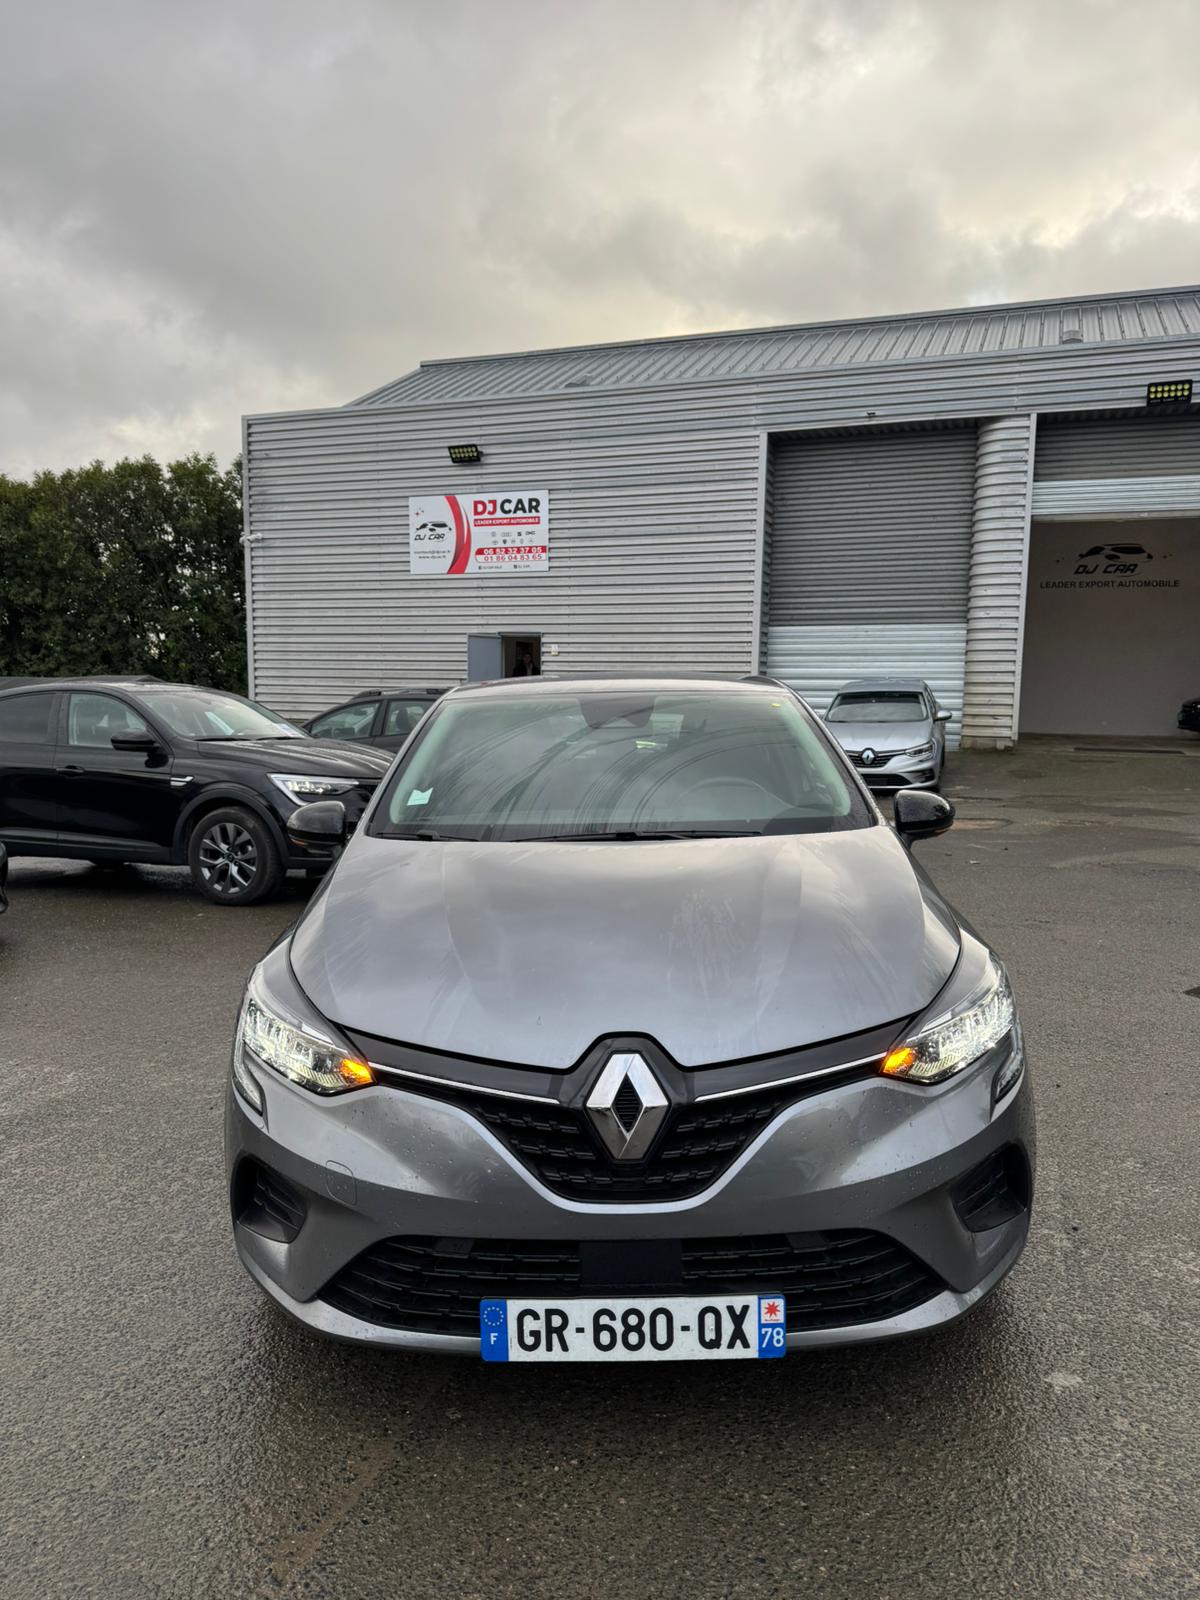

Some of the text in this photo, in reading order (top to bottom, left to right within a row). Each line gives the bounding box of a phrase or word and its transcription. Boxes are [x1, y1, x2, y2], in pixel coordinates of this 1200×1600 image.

[473, 498, 541, 516] DJ CAR
[1074, 563, 1138, 574] DJ CAR
[1040, 579, 1180, 589] LEADER EXPORT AUTOMOBILE
[516, 1304, 751, 1352] GR-680-QX
[490, 1333, 498, 1345] F
[761, 1327, 784, 1348] 78
